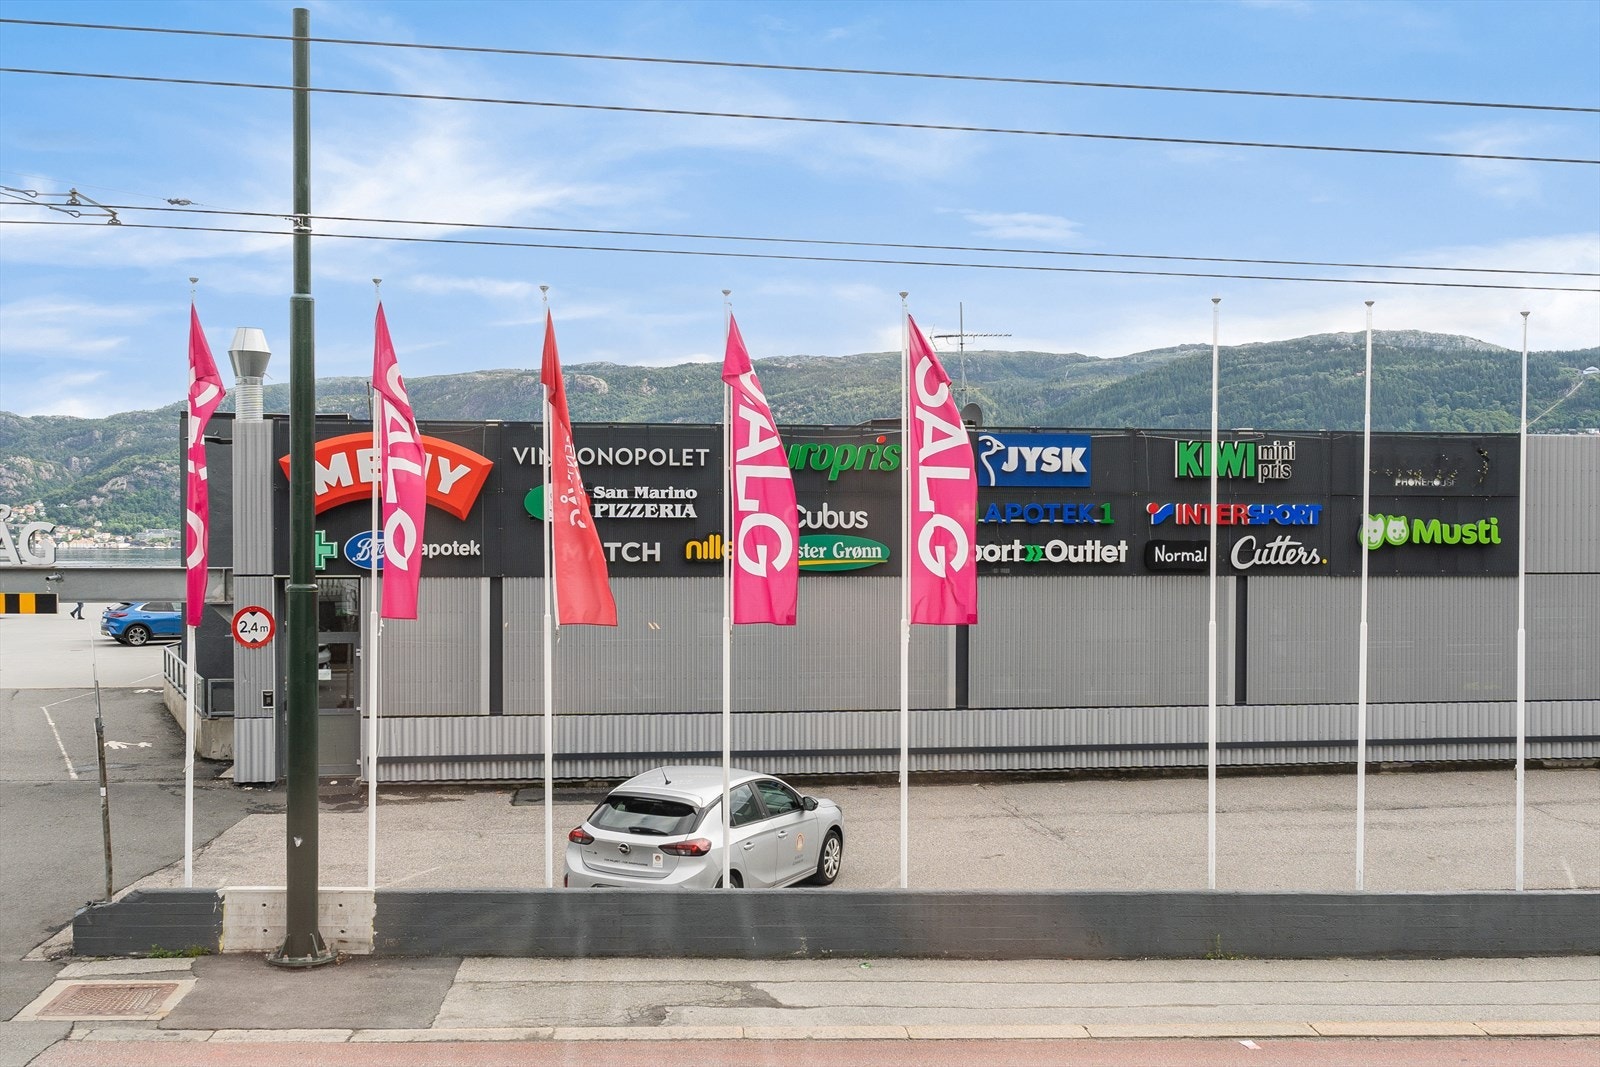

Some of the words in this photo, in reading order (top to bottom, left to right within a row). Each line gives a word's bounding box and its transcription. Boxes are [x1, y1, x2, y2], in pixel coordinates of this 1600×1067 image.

[512, 447, 710, 467] VINONOPOLET
[783, 435, 901, 481] uropris
[1001, 446, 1088, 473] JYSK
[1174, 440, 1257, 478] KIWI
[1258, 440, 1296, 460] mini
[315, 448, 471, 495] MEY
[1258, 459, 1293, 484] pris
[593, 486, 629, 499] San
[634, 486, 698, 499] Marino
[593, 503, 698, 518] PIZZERIA
[983, 502, 1096, 524] APOTEK
[1100, 502, 1115, 524] 1
[1175, 503, 1323, 525] INTERSPORT
[1412, 517, 1502, 545] Musti
[604, 542, 661, 562] TCH
[798, 542, 828, 559] ster
[832, 541, 882, 560] Grønn
[1044, 539, 1129, 563] Outlet
[1155, 544, 1208, 562] Normal
[239, 620, 258, 634] 2,4
